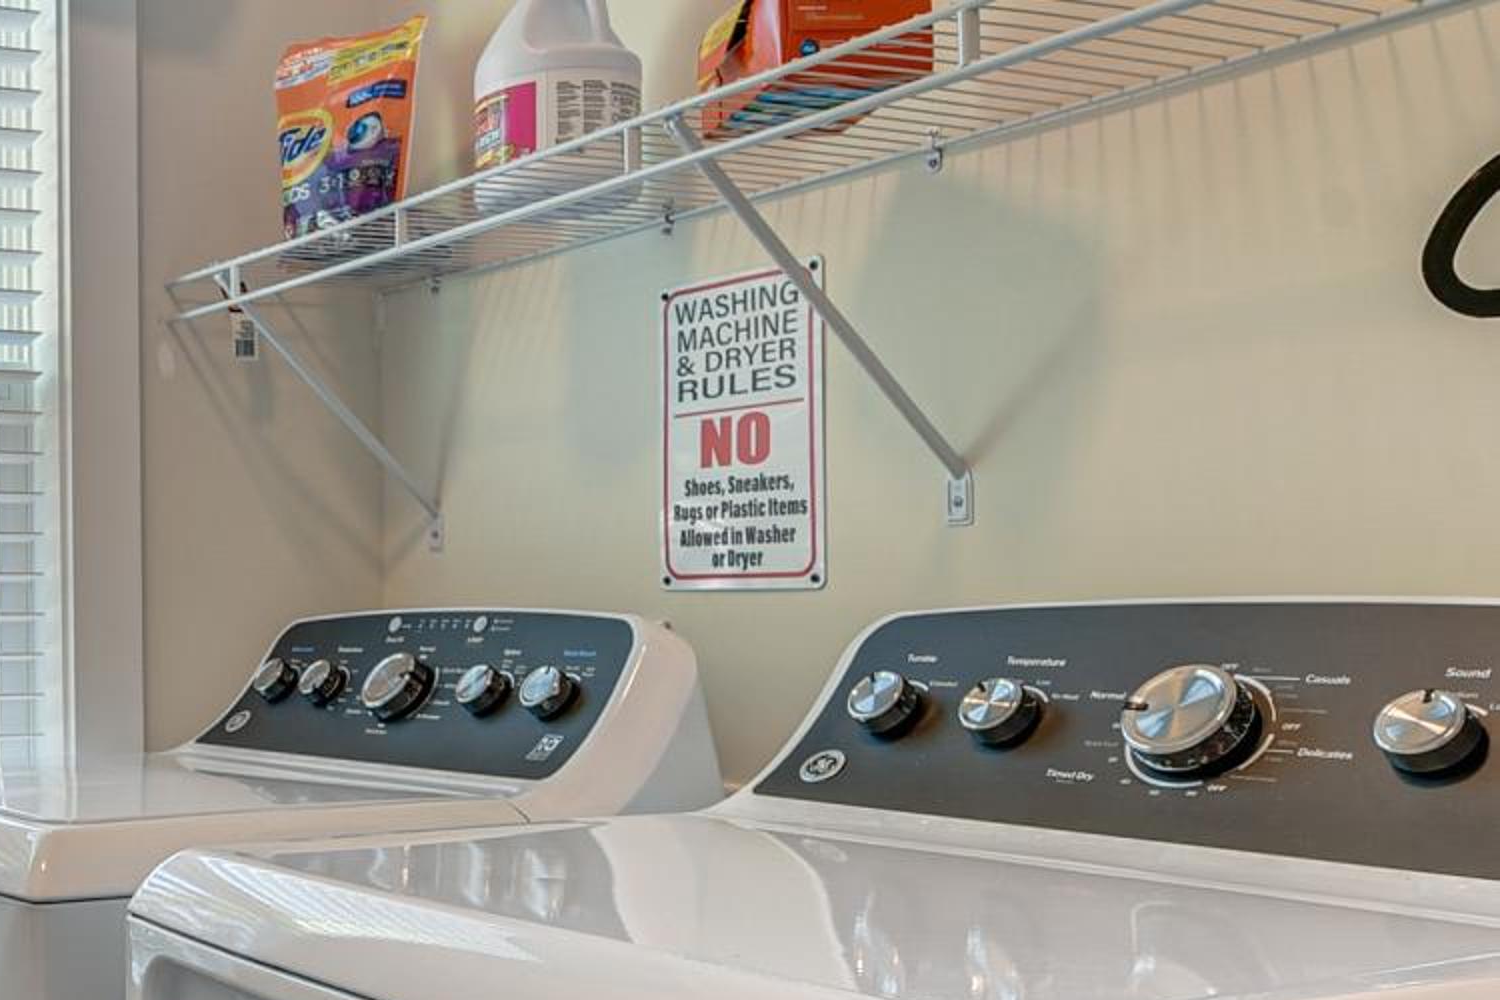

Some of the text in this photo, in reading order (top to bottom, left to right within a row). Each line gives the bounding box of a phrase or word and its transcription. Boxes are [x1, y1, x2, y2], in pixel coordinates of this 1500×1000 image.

[675, 280, 799, 325] WASHING
[677, 309, 799, 353] MACHINE
[677, 338, 796, 377] & DRYER
[678, 364, 796, 402] RULES
[700, 411, 771, 469] NO
[684, 472, 795, 497] Shoes, Sneakers,
[674, 499, 807, 525] Rugs or Plastic Items
[680, 524, 796, 547] Allowed in Washer
[712, 550, 764, 570] or Dryer
[1007, 655, 1067, 668] Temperature
[1445, 667, 1492, 679] Sound
[1305, 673, 1351, 685] Casuals
[1090, 690, 1127, 701] Normal
[1297, 747, 1353, 760] Delicates
[1075, 770, 1095, 783] Dry
